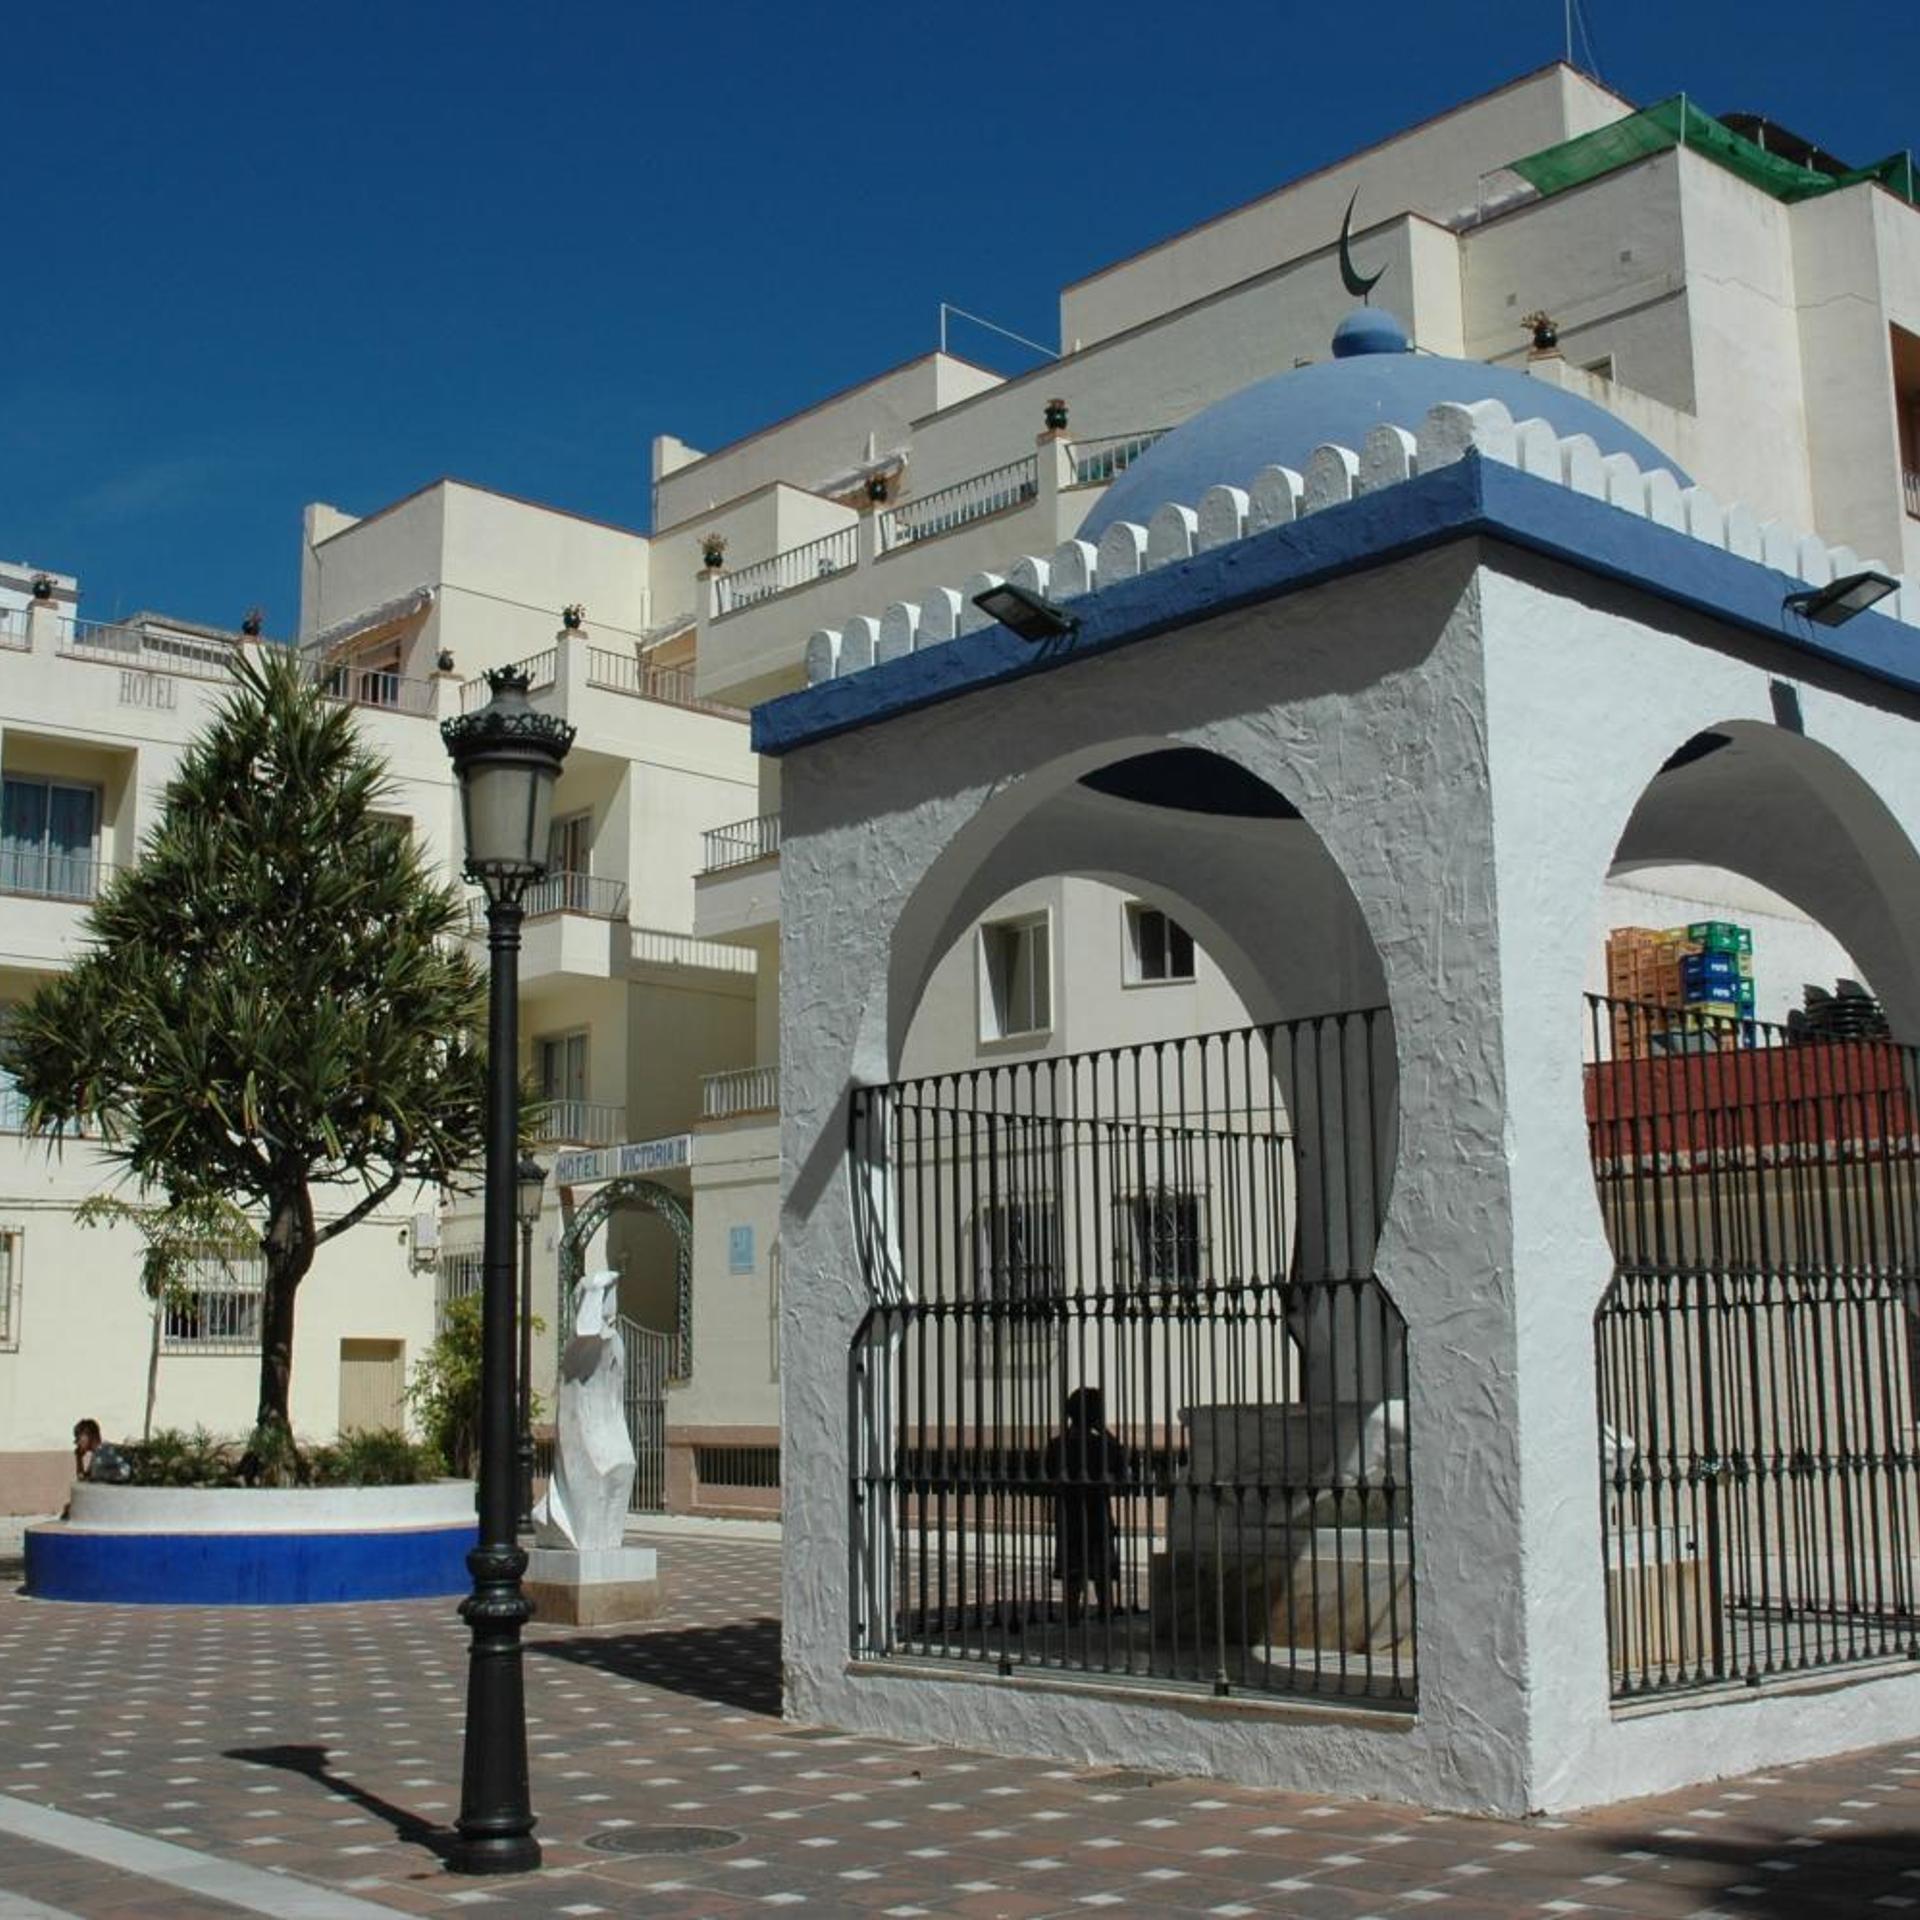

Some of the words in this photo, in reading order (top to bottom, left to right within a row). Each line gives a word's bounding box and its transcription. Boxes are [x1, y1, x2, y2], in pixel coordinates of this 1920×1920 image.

[120, 671, 177, 710] HOTEL
[557, 1153, 601, 1180] HOTEL
[621, 1142, 673, 1172] VICTORIA
